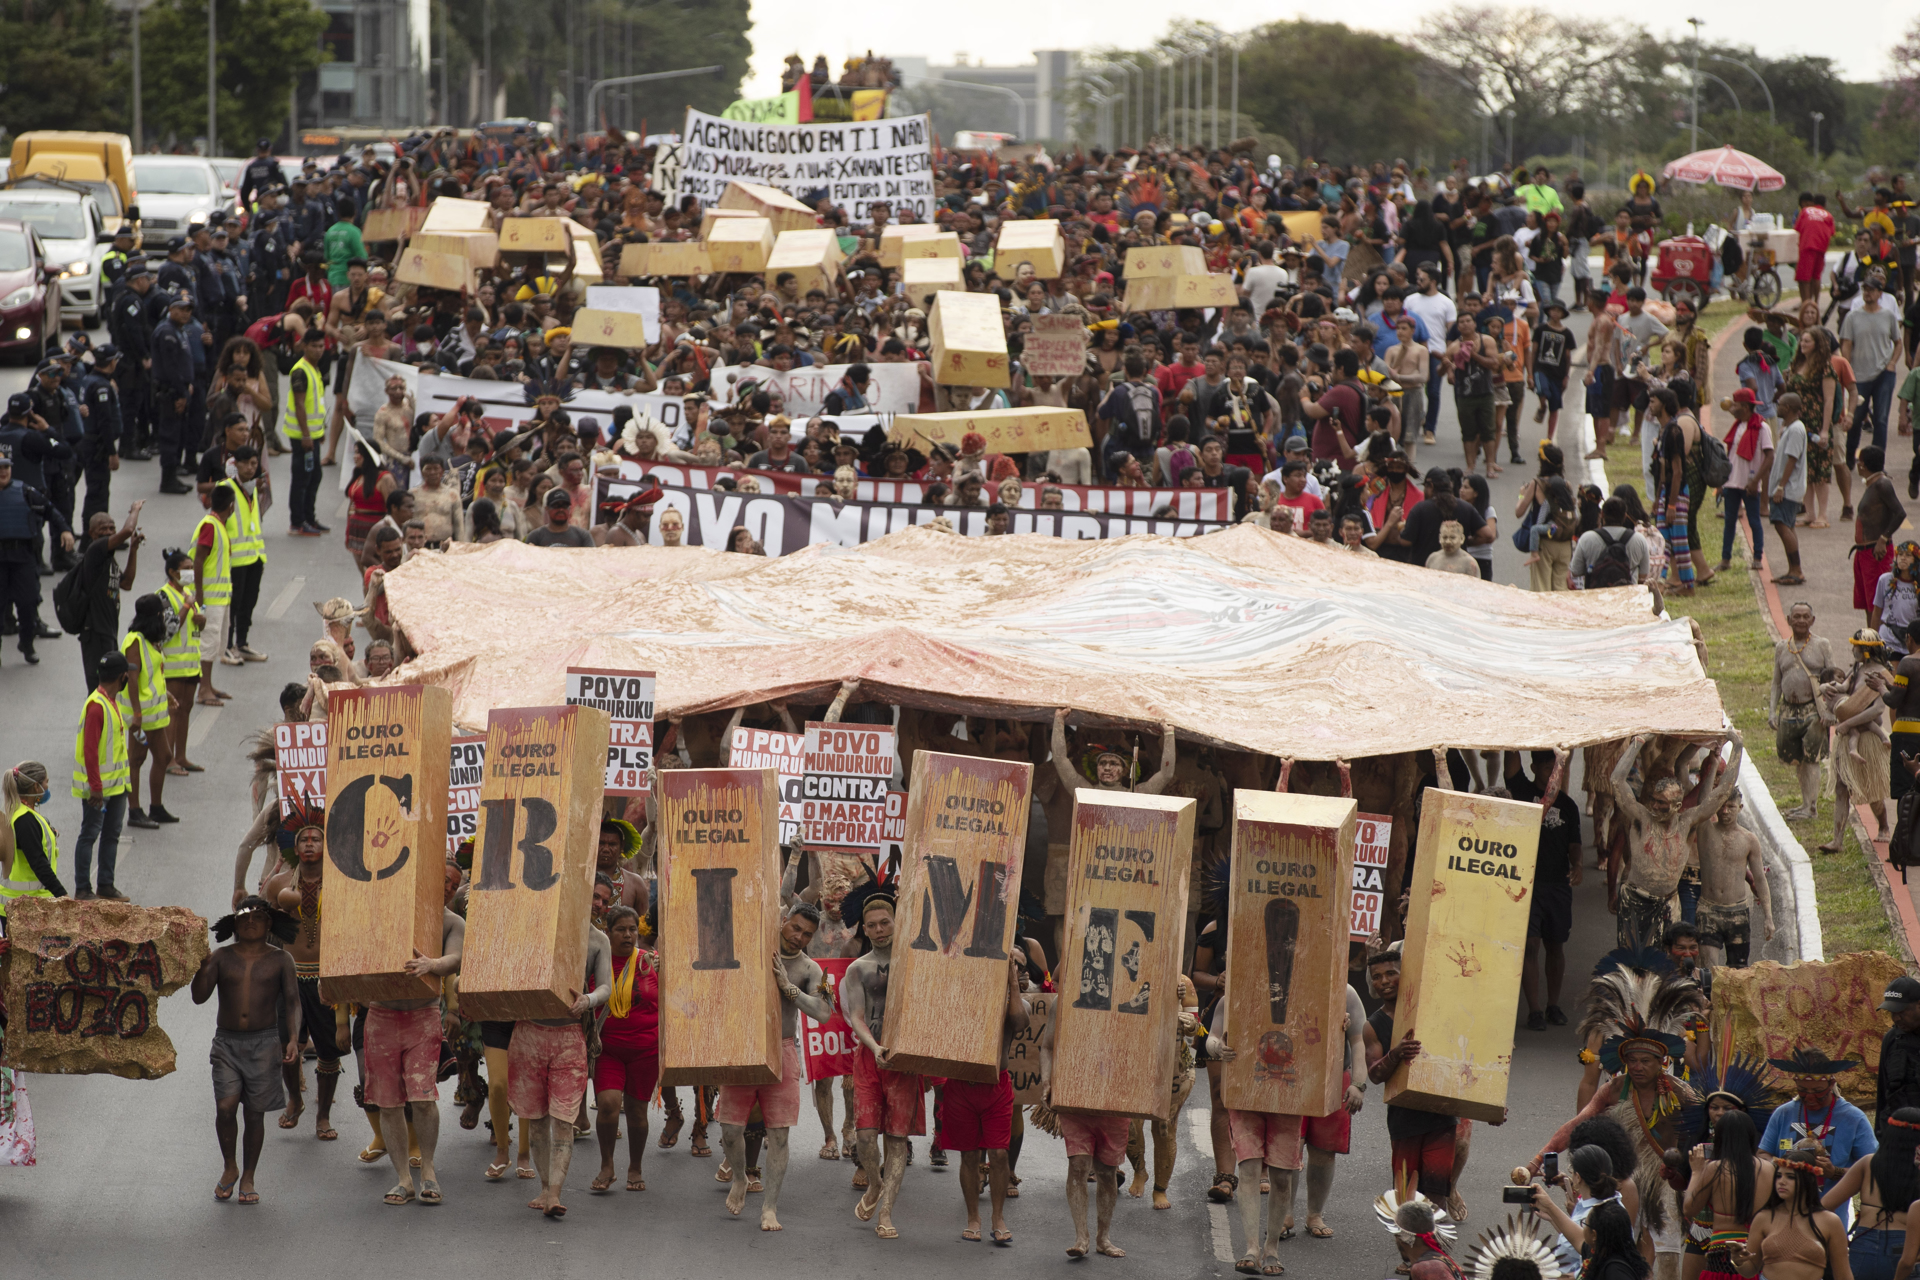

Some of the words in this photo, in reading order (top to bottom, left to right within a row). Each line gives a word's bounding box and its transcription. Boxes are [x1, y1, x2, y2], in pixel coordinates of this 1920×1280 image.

[819, 130, 844, 152] EM
[735, 375, 882, 407] ARIMO
[608, 484, 785, 558] OVO
[580, 675, 641, 700] POVO
[276, 725, 291, 748] O
[295, 723, 328, 748] PO
[347, 723, 404, 741] OURO
[609, 722, 652, 745] TRA
[732, 728, 748, 749] O
[818, 730, 880, 755] POVO
[278, 746, 328, 769] MUNDU
[339, 743, 410, 761] ILEGAL
[500, 743, 557, 759] OURO
[491, 761, 561, 778] ILEGAL
[730, 750, 804, 776] MUNDURU
[804, 752, 893, 776] MUNDURUKU
[280, 770, 326, 798] EXI
[449, 765, 483, 787] UND
[613, 769, 649, 788] 490
[803, 775, 888, 800] CONTRA
[683, 809, 743, 824] OURO
[803, 801, 816, 820] O
[819, 803, 884, 824] MARCO
[885, 793, 902, 817] O
[945, 794, 1005, 816] OURO
[447, 813, 477, 836] OS
[935, 813, 1010, 837] ILEGAL
[472, 797, 561, 891] R
[676, 829, 751, 844] ILEGAL
[1457, 836, 1518, 859] OURO
[1095, 845, 1155, 865] OURO
[1084, 864, 1160, 885] ILEGAL
[1255, 860, 1317, 879] OURO
[1353, 867, 1383, 891] RA
[1447, 855, 1522, 881] ILEGAL
[1247, 879, 1323, 899] ILEGAL
[1352, 892, 1379, 913] CO
[34, 935, 163, 990] FORA
[1072, 907, 1156, 1015] E
[25, 981, 150, 1040] BOZO
[1759, 974, 1879, 1026] FORA
